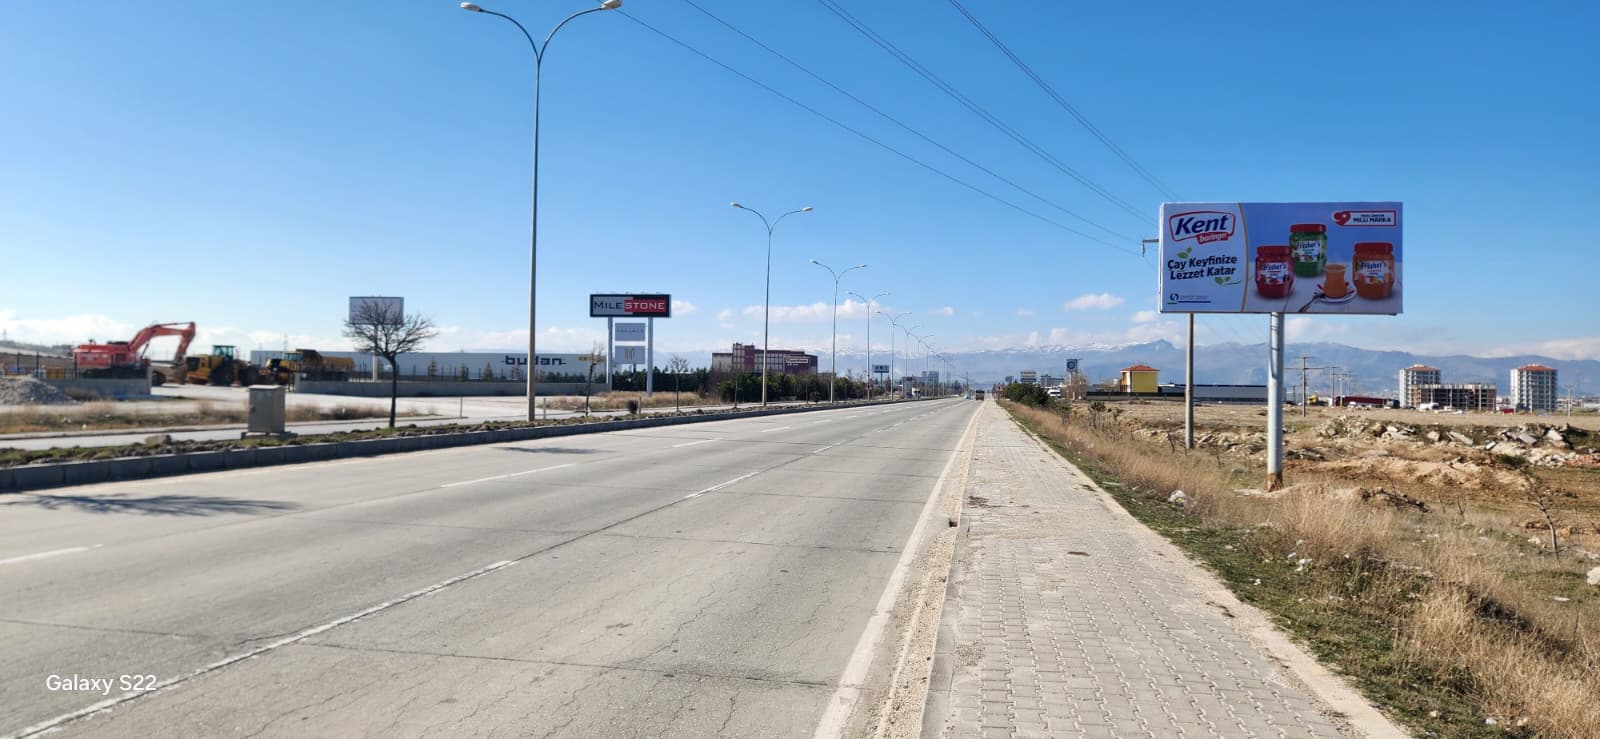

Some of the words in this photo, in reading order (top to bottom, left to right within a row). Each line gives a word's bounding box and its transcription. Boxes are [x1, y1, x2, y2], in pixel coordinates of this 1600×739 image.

[1175, 215, 1230, 236] Kent
[1167, 259, 1186, 271] Çay
[1189, 254, 1238, 268] Keyfinize
[1170, 269, 1205, 280] Lezzet
[1207, 266, 1236, 277] Katar
